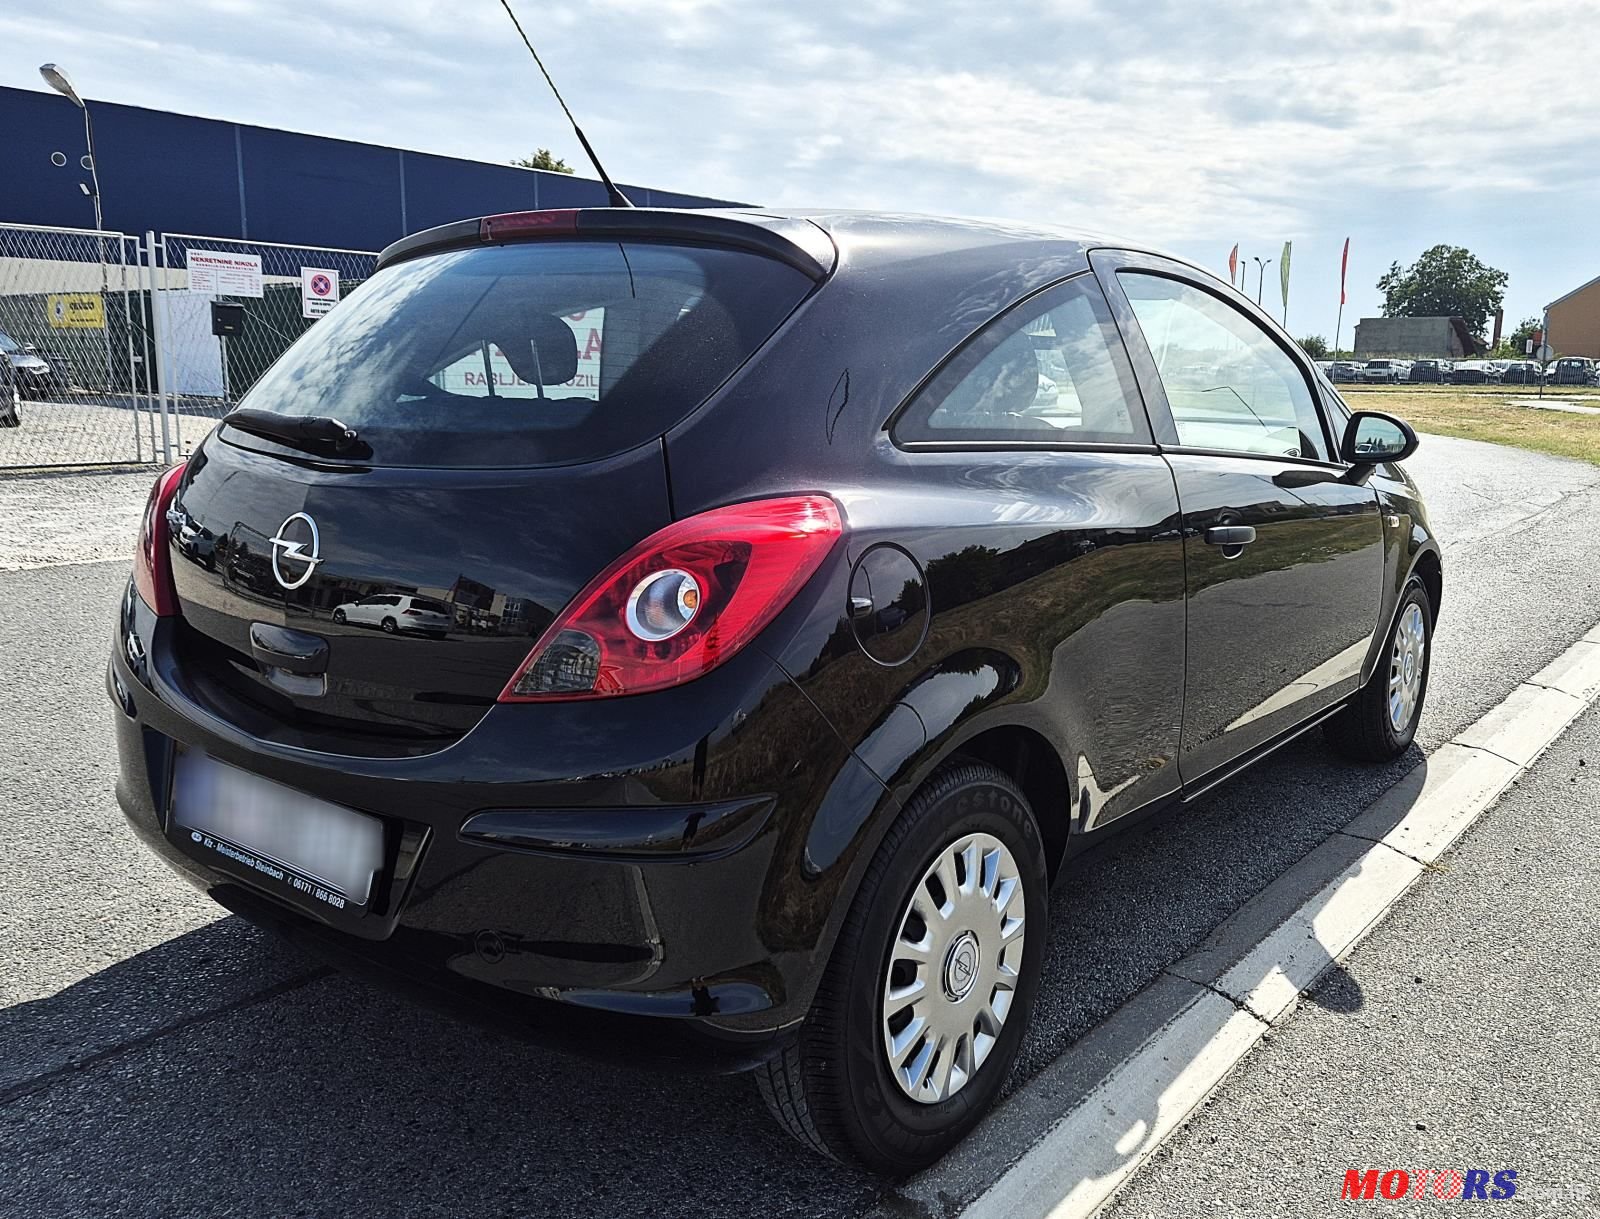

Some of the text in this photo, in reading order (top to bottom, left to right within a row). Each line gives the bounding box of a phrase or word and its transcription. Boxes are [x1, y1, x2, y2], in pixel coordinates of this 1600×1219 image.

[190, 256, 233, 266] NEKRETNINE
[234, 259, 258, 268] NIKOLA
[464, 371, 598, 387] RABLJE OZIL
[215, 842, 255, 867] Meisterbetrieb
[254, 860, 284, 880] Steinbach
[293, 878, 312, 894] 06171
[328, 893, 345, 909] 8028
